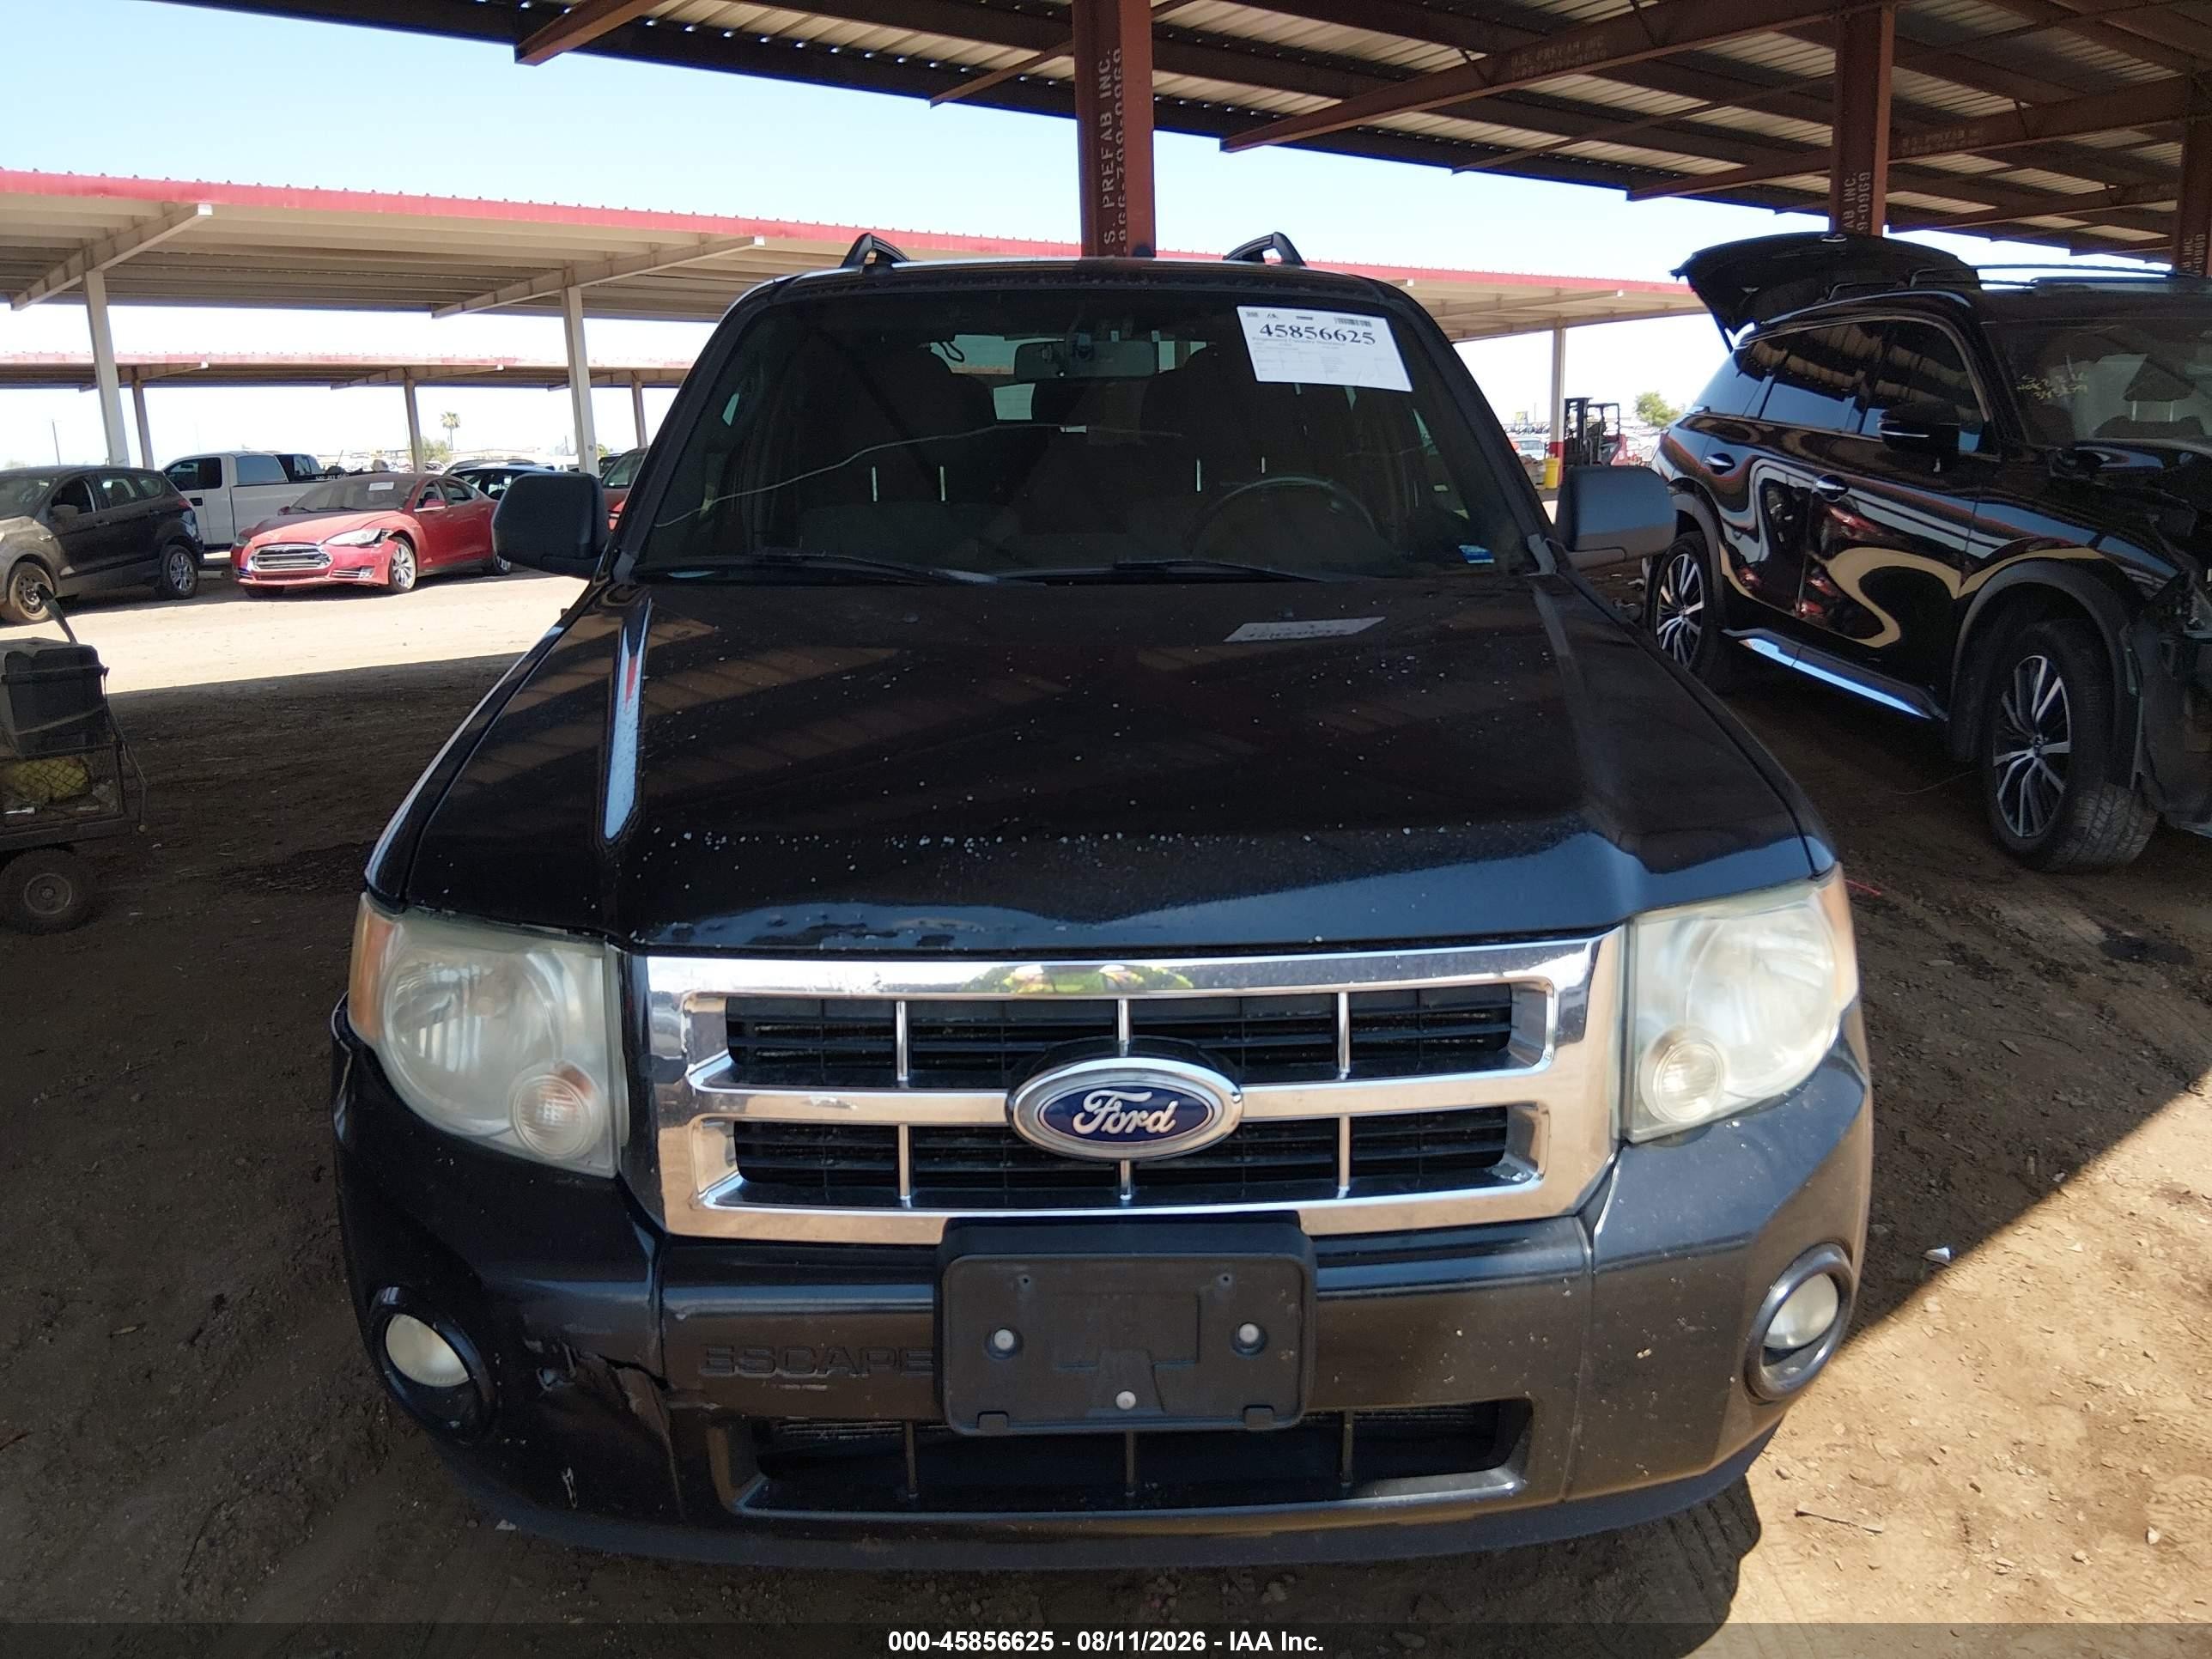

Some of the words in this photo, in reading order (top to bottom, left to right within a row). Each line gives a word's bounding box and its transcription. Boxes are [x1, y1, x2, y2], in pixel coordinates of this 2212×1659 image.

[1099, 48, 1111, 99] INC.
[1100, 111, 1115, 208] PREFAB
[1259, 324, 1376, 344] 45856625
[1073, 1090, 1179, 1134] Ford
[700, 1344, 934, 1377] ESCAPE
